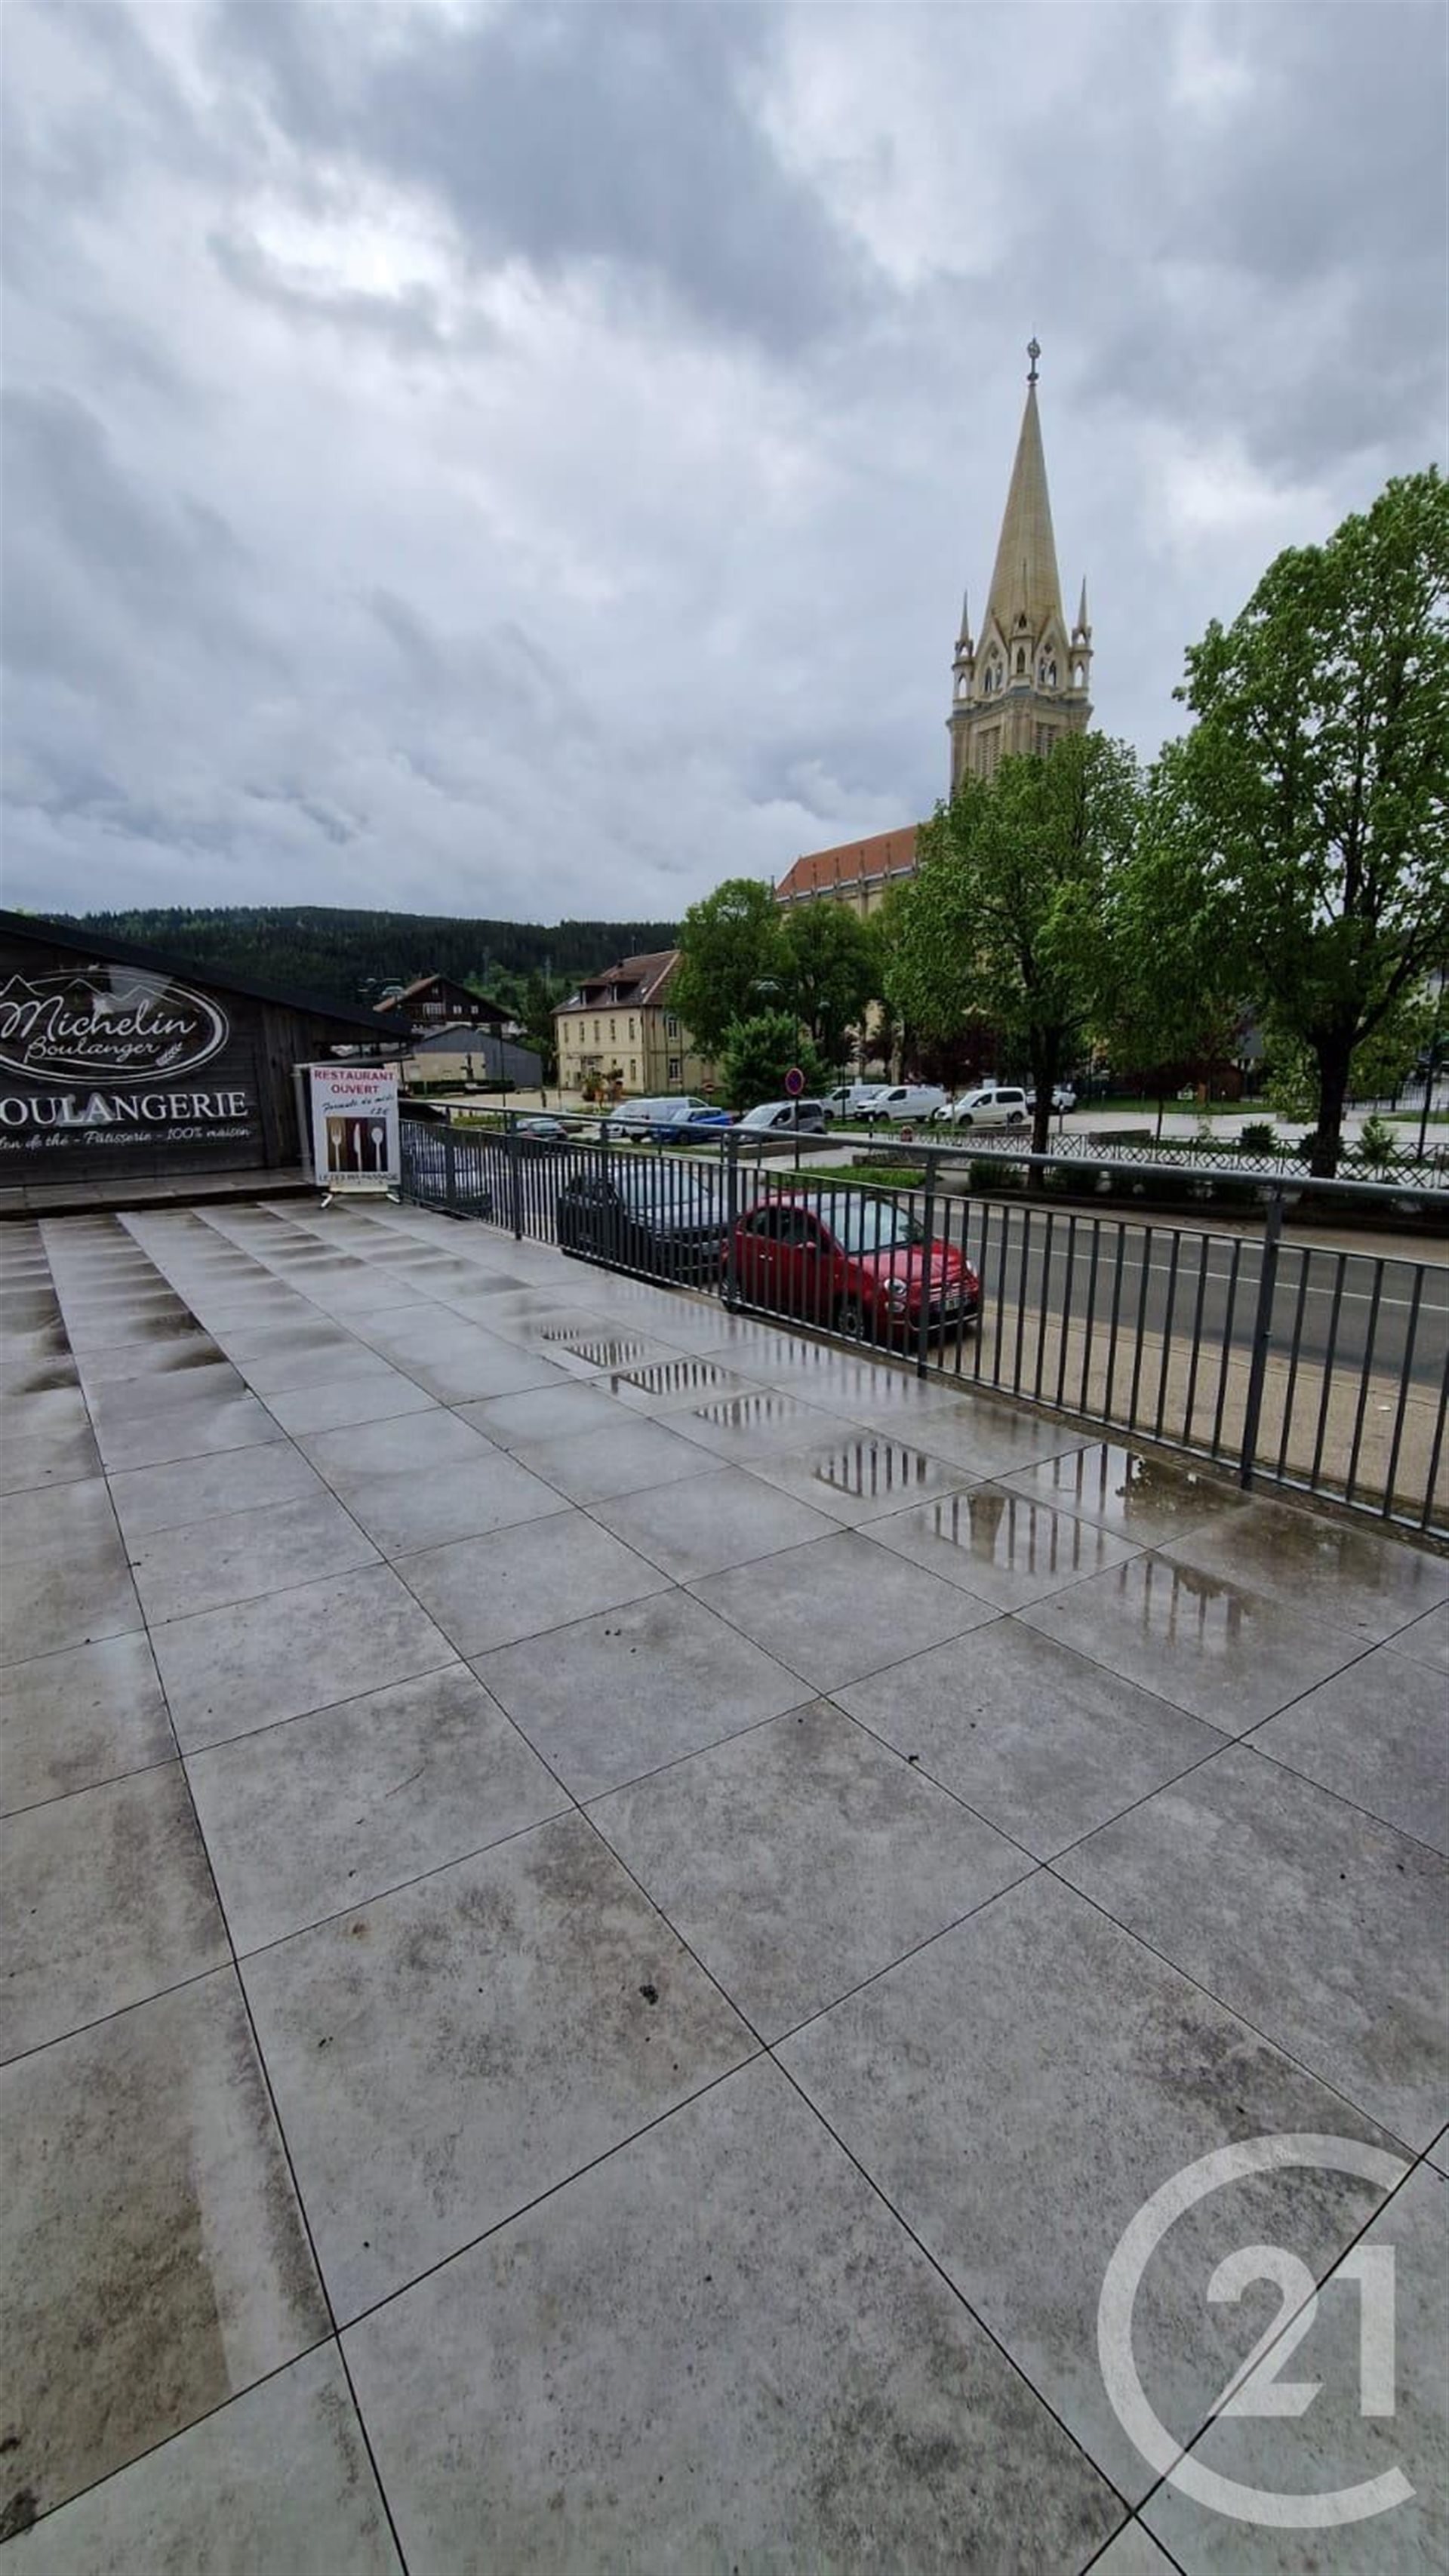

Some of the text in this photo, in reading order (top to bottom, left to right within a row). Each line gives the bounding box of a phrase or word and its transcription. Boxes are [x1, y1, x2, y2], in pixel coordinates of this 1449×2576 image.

[0, 996, 197, 1042] Michelin
[23, 1036, 160, 1063] Boulanger
[314, 1069, 393, 1081] RESTAURANT
[331, 1084, 379, 1094] OUVERT
[168, 1127, 203, 1140] 100%
